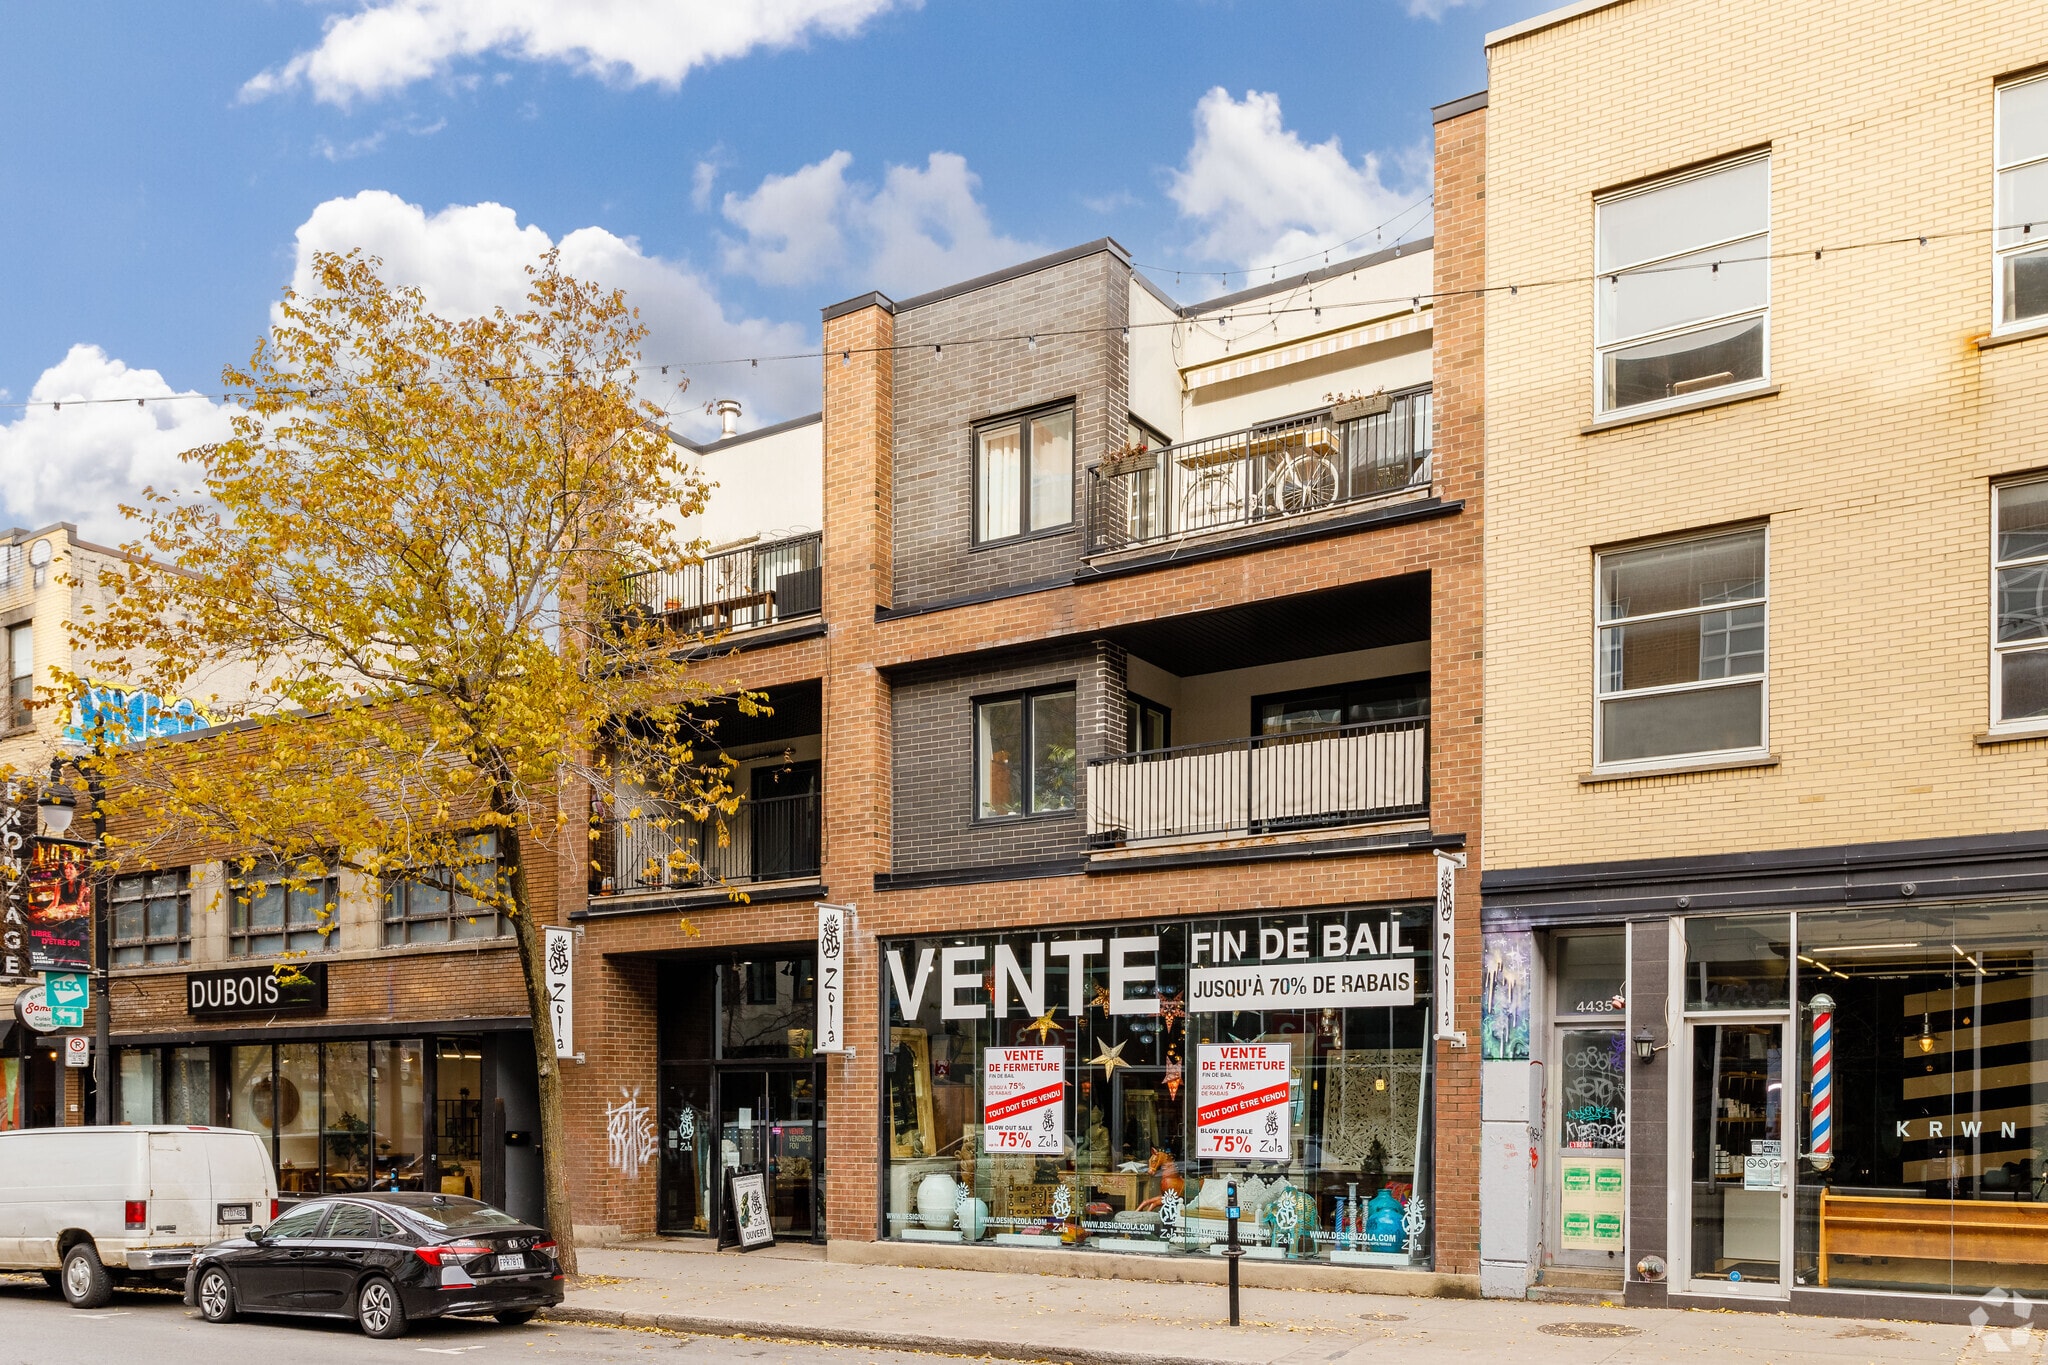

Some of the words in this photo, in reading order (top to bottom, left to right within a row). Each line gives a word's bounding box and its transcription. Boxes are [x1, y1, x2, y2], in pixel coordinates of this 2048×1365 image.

[31, 930, 52, 938] LIBRE
[1191, 930, 1247, 963] FIN
[1259, 926, 1310, 961] DE
[1323, 921, 1414, 958] BAIL
[886, 936, 1160, 1020] VENTE
[1442, 933, 1451, 1026] Zola
[51, 980, 80, 992] CLSC
[1193, 974, 1264, 998] JUSQU'À
[1269, 976, 1307, 996] 70%
[1313, 975, 1336, 994] DE
[1341, 972, 1410, 993] RABAIS
[191, 975, 279, 1008] DUBOIS
[824, 968, 838, 1042] Zola
[1576, 1000, 1613, 1012] 4435
[552, 983, 566, 1049] Zola
[1004, 1050, 1044, 1060] VENTE
[1220, 1047, 1267, 1059] VENTE
[989, 1063, 1001, 1072] DE
[1003, 1062, 1060, 1072] FERMETURE
[1202, 1061, 1216, 1071] DE
[1219, 1060, 1286, 1071] FERMETURE
[1008, 1082, 1026, 1090] 75%
[1224, 1082, 1245, 1090] 75%
[988, 1107, 1005, 1118] TOUT
[1005, 1102, 1020, 1113] DOIT
[1021, 1096, 1038, 1108] ÊTRE
[1038, 1089, 1061, 1102] VENDU
[1201, 1108, 1220, 1120] TOUT
[1221, 1103, 1239, 1115] DOIT
[1240, 1097, 1260, 1109] ÊTRE
[1260, 1090, 1286, 1104] VENDU
[998, 1131, 1032, 1148] 75%
[1038, 1134, 1059, 1148] Zola
[1213, 1135, 1252, 1153] 75%
[1260, 1138, 1283, 1153] Zola
[680, 1141, 693, 1152] Zola
[980, 1216, 1048, 1225] WWW.DESIGNZOLA.COM
[1081, 1220, 1155, 1231] WWW.DESIGNZOLA.COM
[1052, 1221, 1069, 1233] Zola
[745, 1228, 767, 1240] OUVERT
[1309, 1230, 1397, 1243] WWW.DESIGNZOLA.COM
